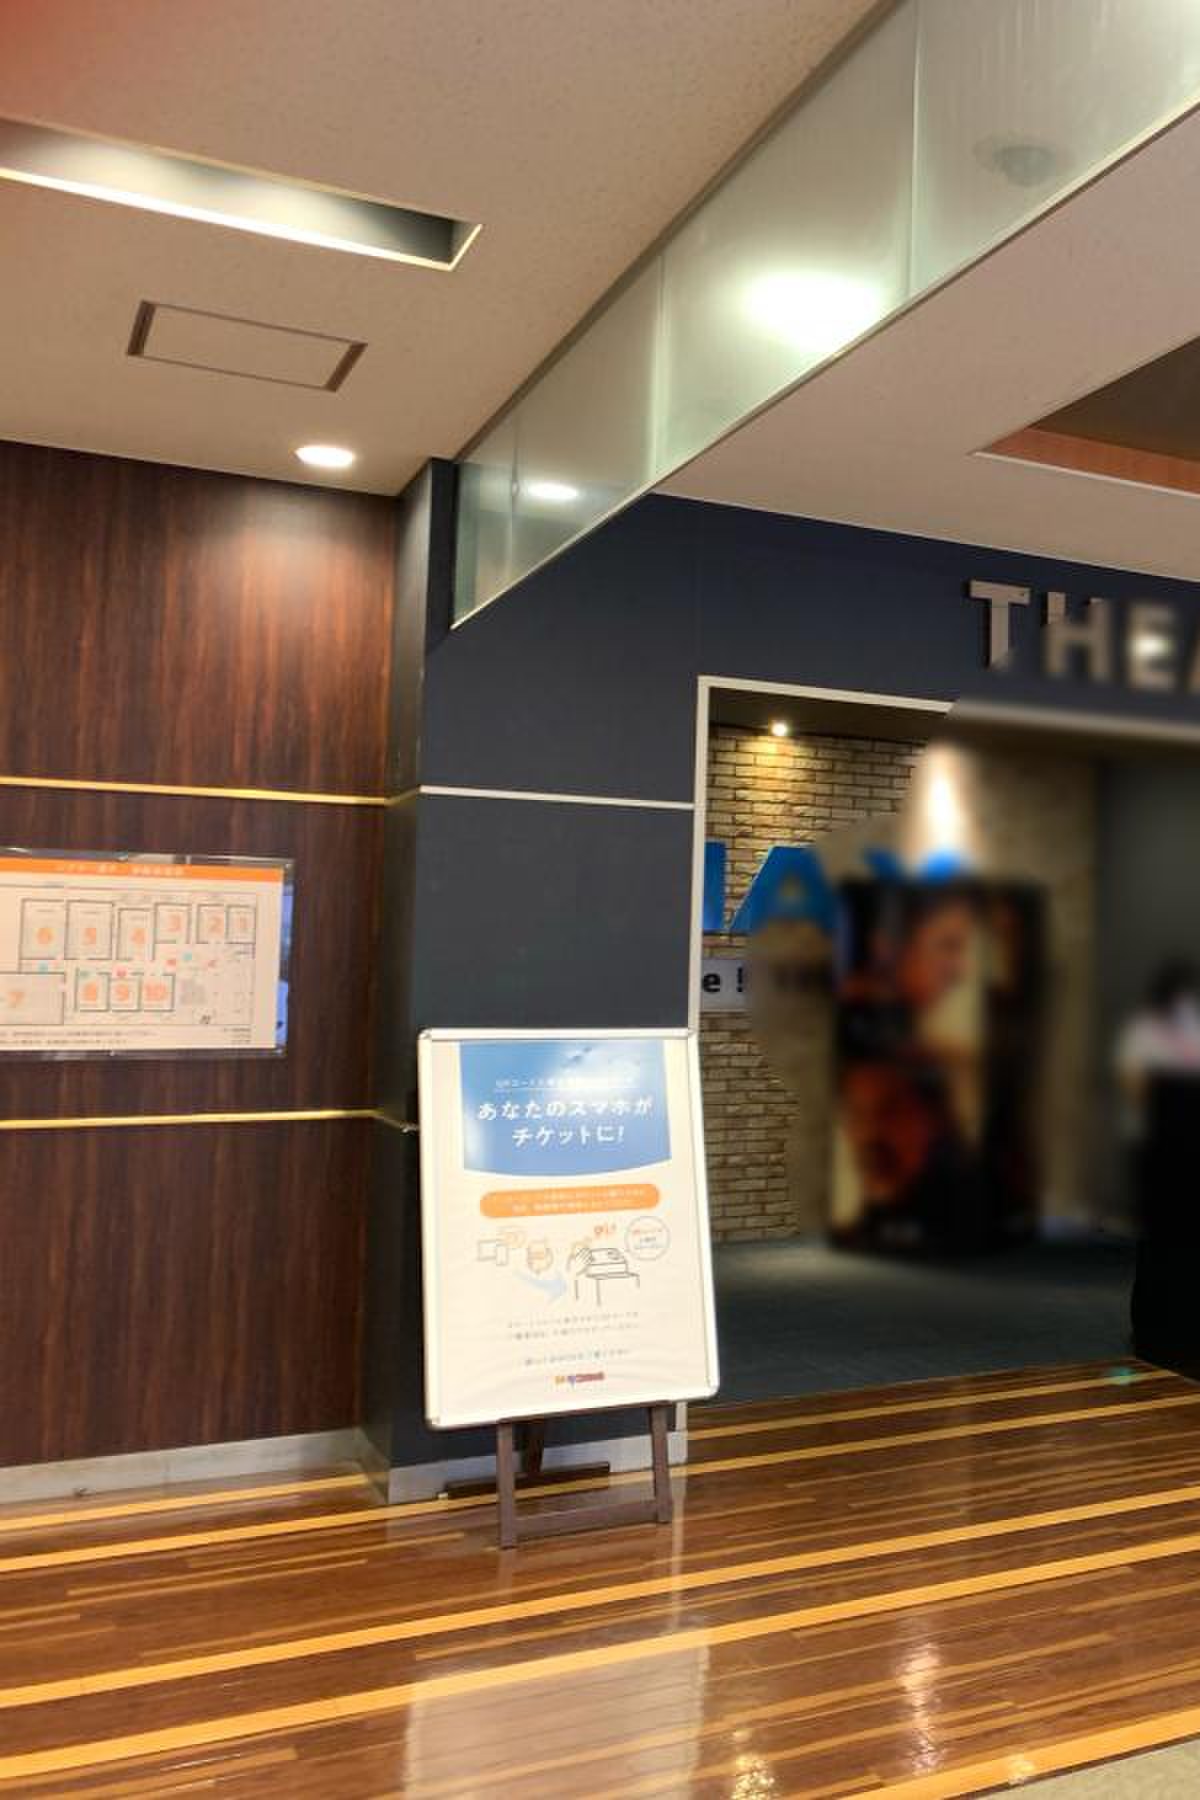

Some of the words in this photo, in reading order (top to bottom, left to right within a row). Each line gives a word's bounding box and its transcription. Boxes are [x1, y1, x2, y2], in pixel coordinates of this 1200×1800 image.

[477, 1096, 654, 1122] あなたのスマホが
